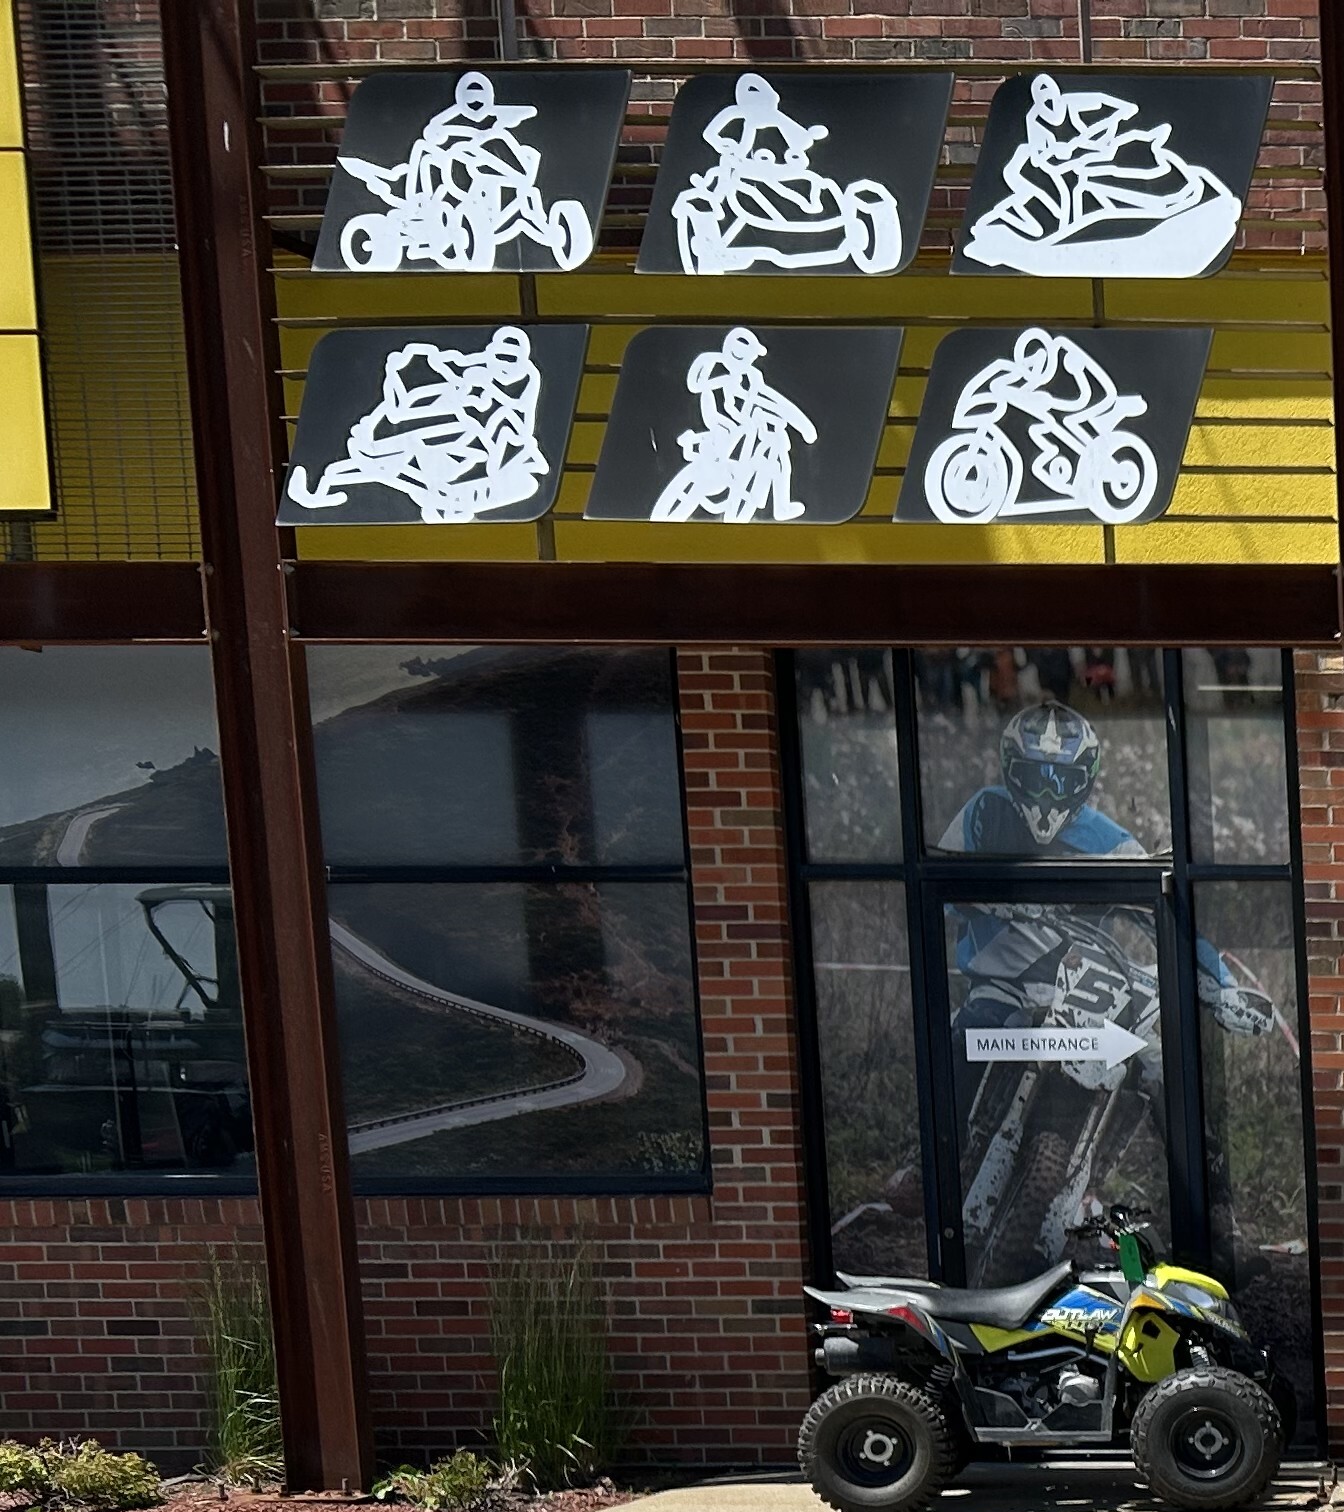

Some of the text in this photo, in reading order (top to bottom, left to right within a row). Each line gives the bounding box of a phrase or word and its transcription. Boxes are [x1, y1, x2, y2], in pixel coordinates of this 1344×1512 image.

[976, 1037, 1099, 1051] MAIN ENTRANCE
[1041, 1307, 1119, 1323] OUTLAW
